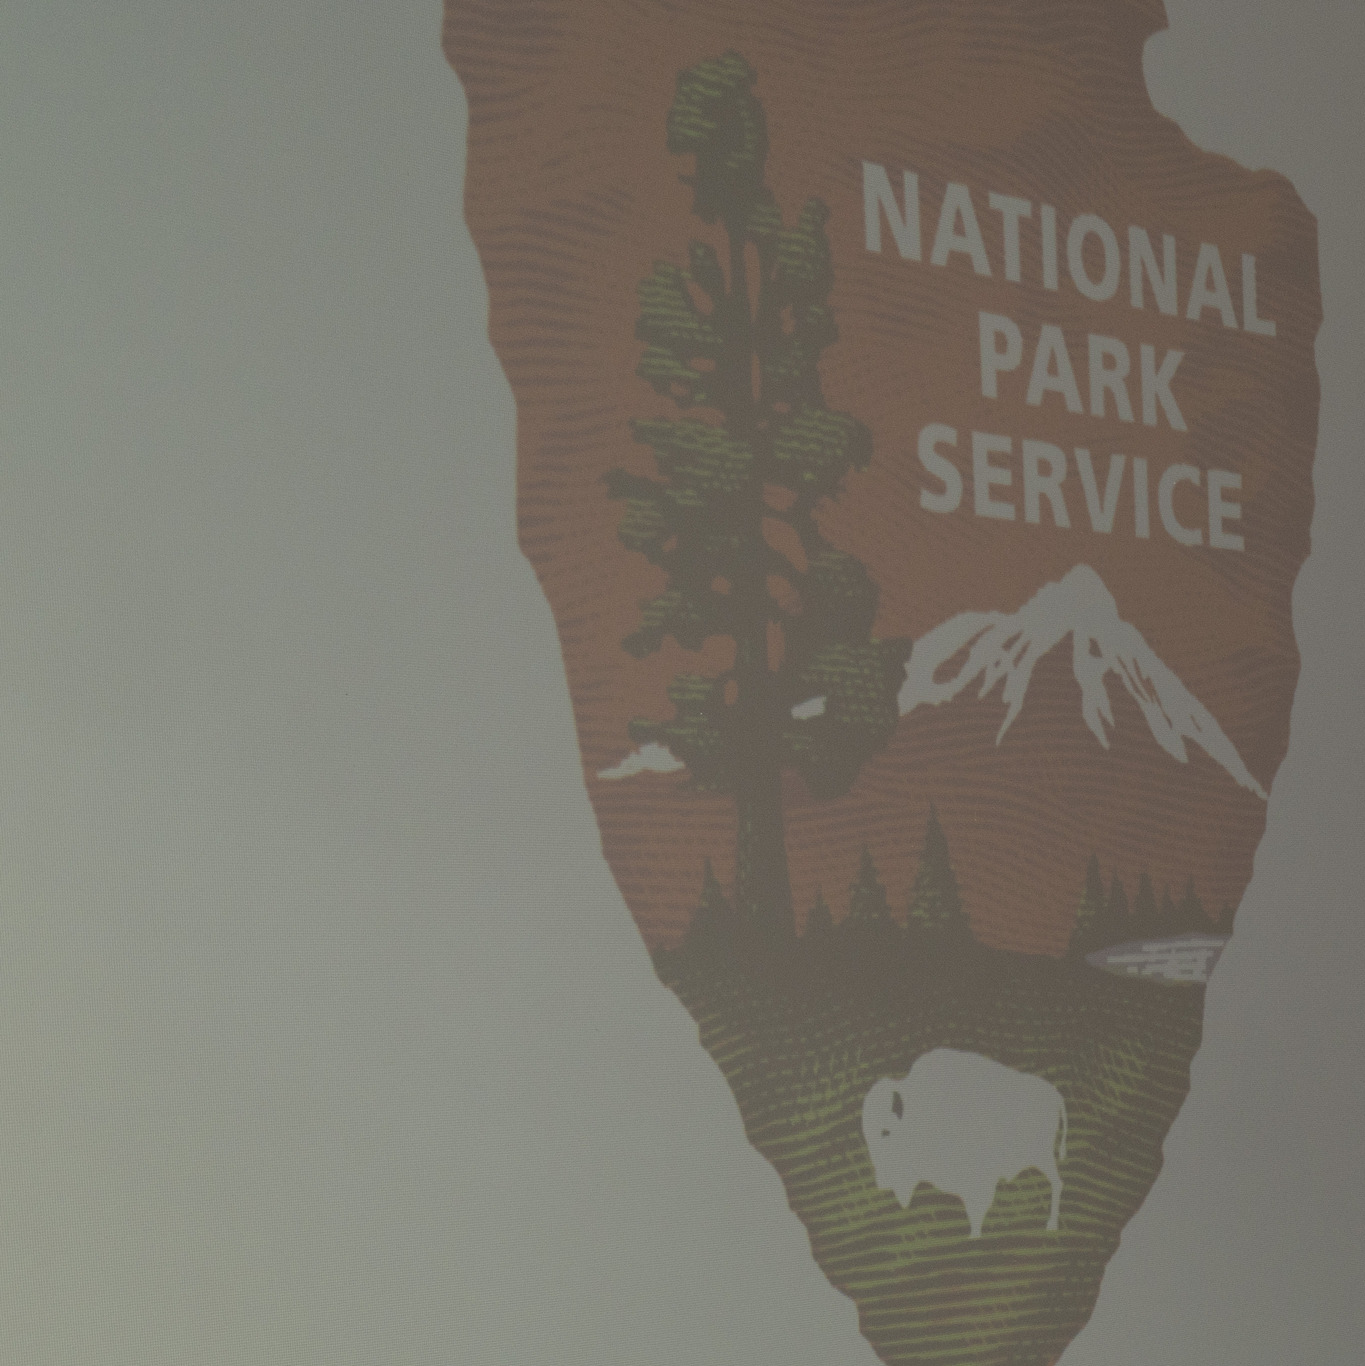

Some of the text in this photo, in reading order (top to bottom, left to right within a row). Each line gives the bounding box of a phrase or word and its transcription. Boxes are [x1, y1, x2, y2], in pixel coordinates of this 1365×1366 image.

[862, 160, 1277, 337] NATIONAL
[978, 310, 1189, 432] PARK
[916, 422, 1245, 552] SERVICE
